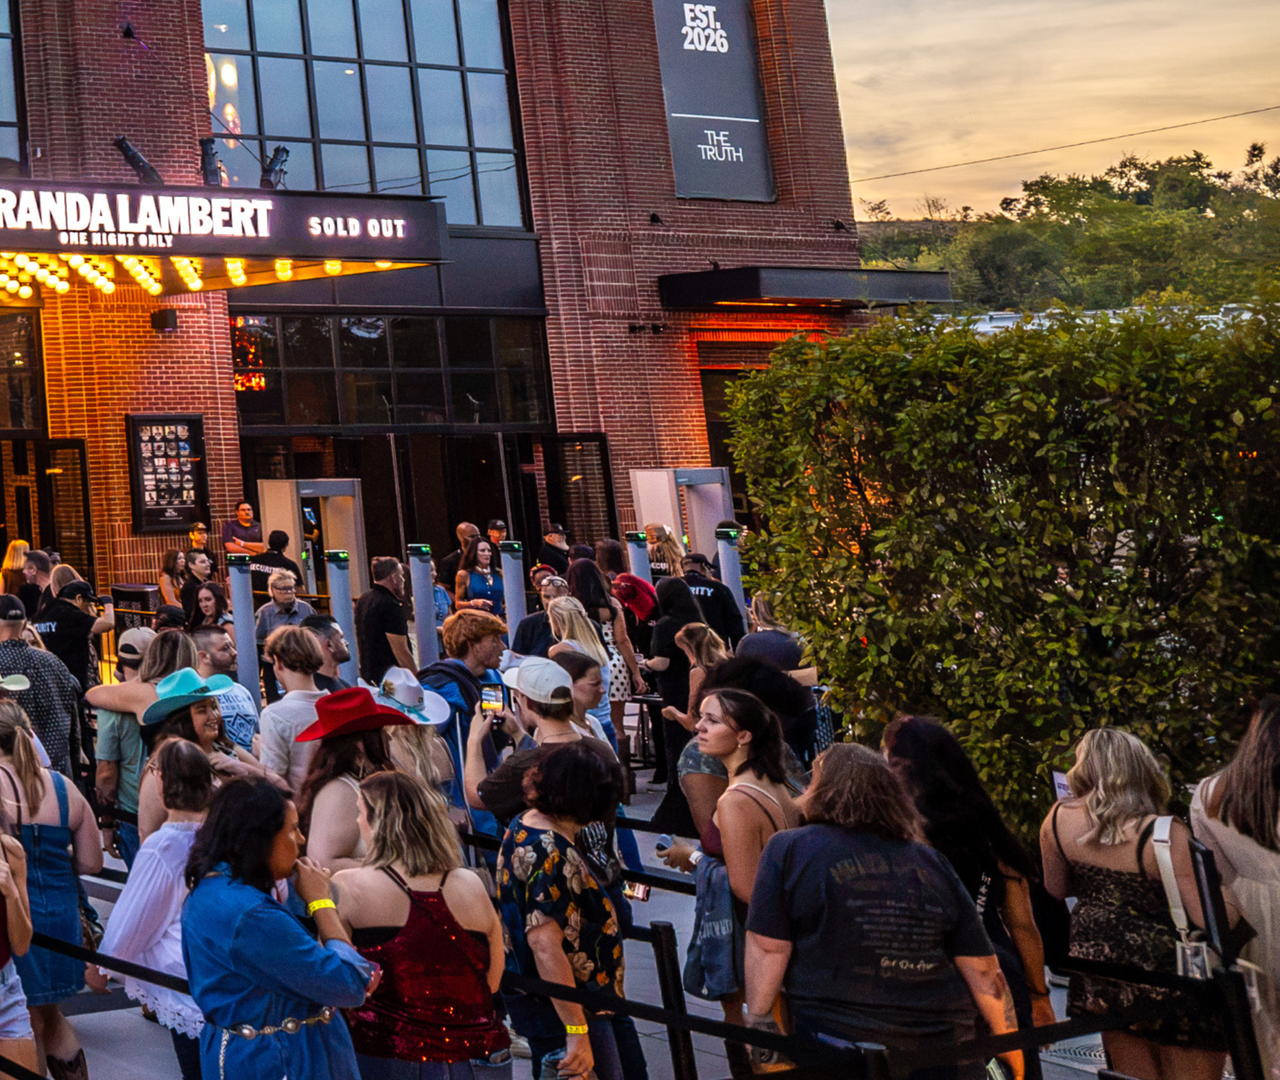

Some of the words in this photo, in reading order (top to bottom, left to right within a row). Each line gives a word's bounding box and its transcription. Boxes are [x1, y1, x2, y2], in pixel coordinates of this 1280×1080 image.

[683, 3, 721, 29] EST.
[681, 25, 729, 53] 2026
[704, 129, 731, 147] THE
[697, 144, 744, 162] TRUTH
[118, 193, 273, 238] LAMBERT
[308, 215, 361, 237] SOLD
[367, 218, 406, 239] OUT
[59, 231, 89, 246] ONE
[92, 231, 135, 247] NIGHT
[139, 233, 173, 248] ONLY
